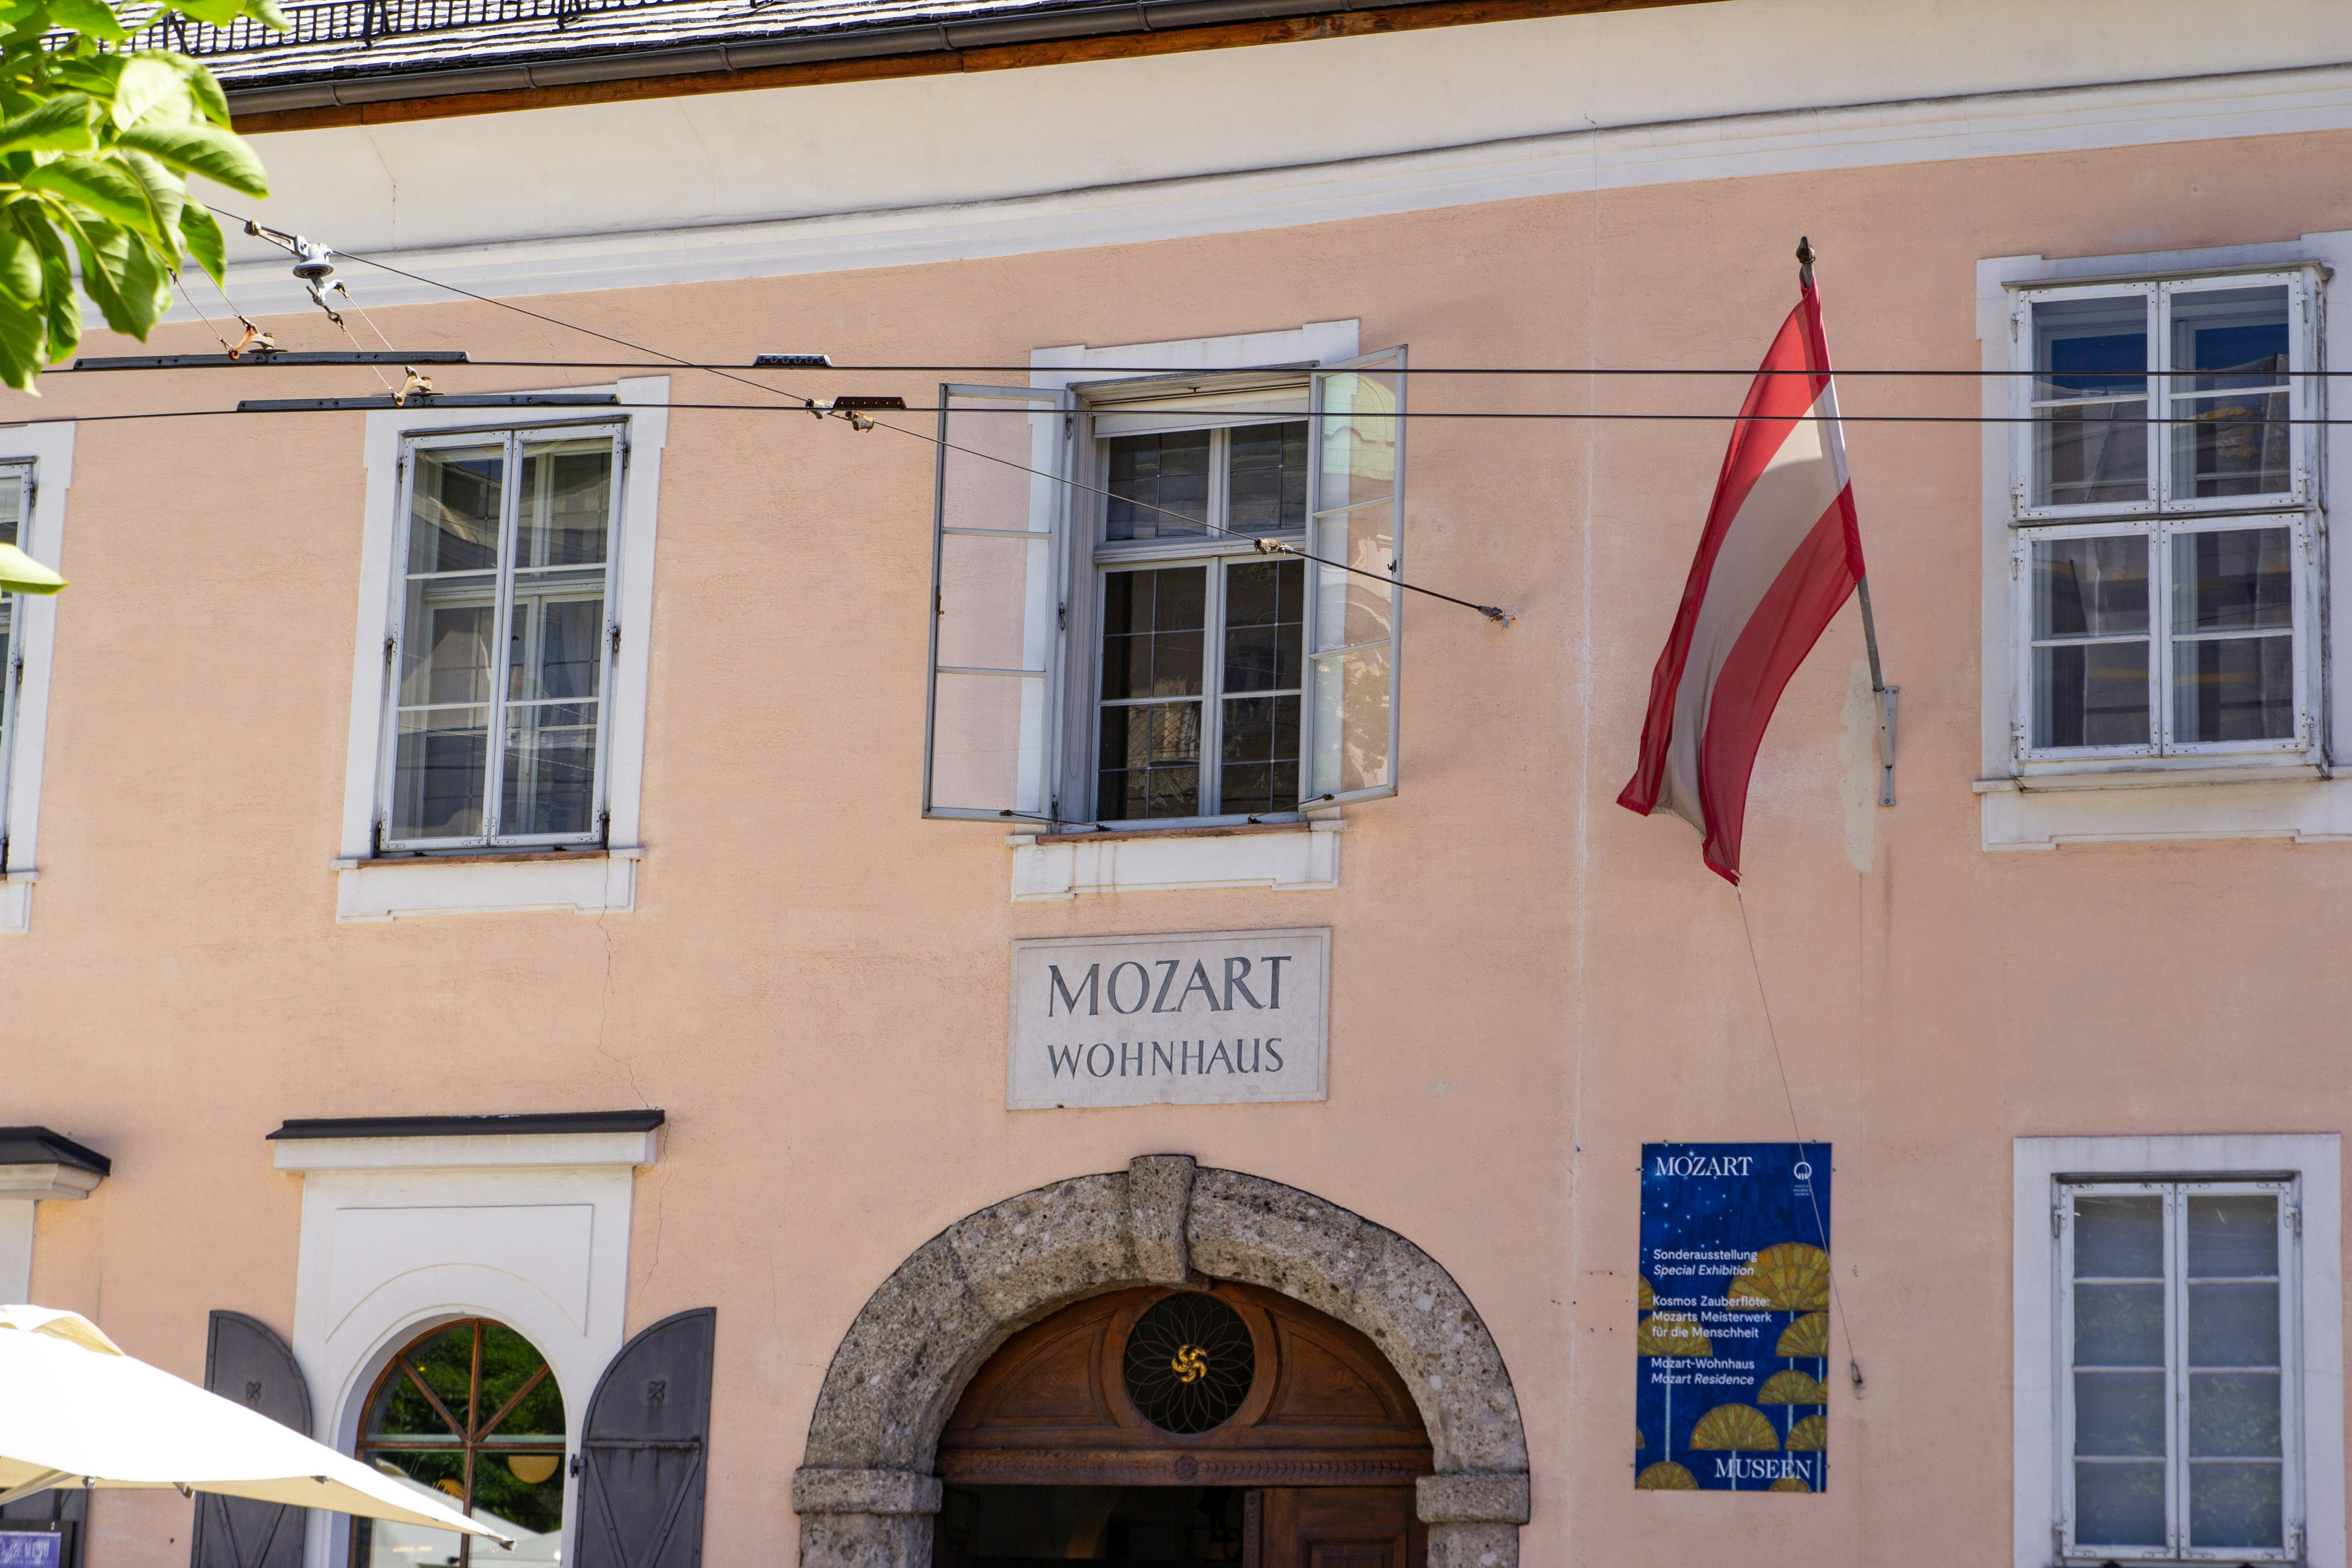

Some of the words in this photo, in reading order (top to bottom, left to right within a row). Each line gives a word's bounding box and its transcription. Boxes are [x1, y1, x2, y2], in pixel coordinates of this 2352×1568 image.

[1048, 956, 1292, 1017] MOZART
[1047, 1038, 1284, 1079] WOHNHAUS
[1655, 1156, 1753, 1176] MOZART
[1653, 1249, 1758, 1263] Sonderausstellung
[1653, 1264, 1696, 1277] Special
[1698, 1264, 1754, 1276] Exhibition
[1652, 1295, 1697, 1307] Kosmos
[1700, 1295, 1770, 1307] Zauberflöte:
[1652, 1311, 1698, 1322] Mozarts
[1701, 1311, 1772, 1323] Meisterwerk
[1652, 1327, 1668, 1337] für
[1671, 1327, 1689, 1338] die
[1692, 1327, 1759, 1338] Menschheit
[1651, 1357, 1755, 1370] Mozart-Wohnhaus
[1651, 1372, 1692, 1384] Mozart
[1694, 1372, 1755, 1385] Residence
[1714, 1458, 1813, 1480] MUSEEN
